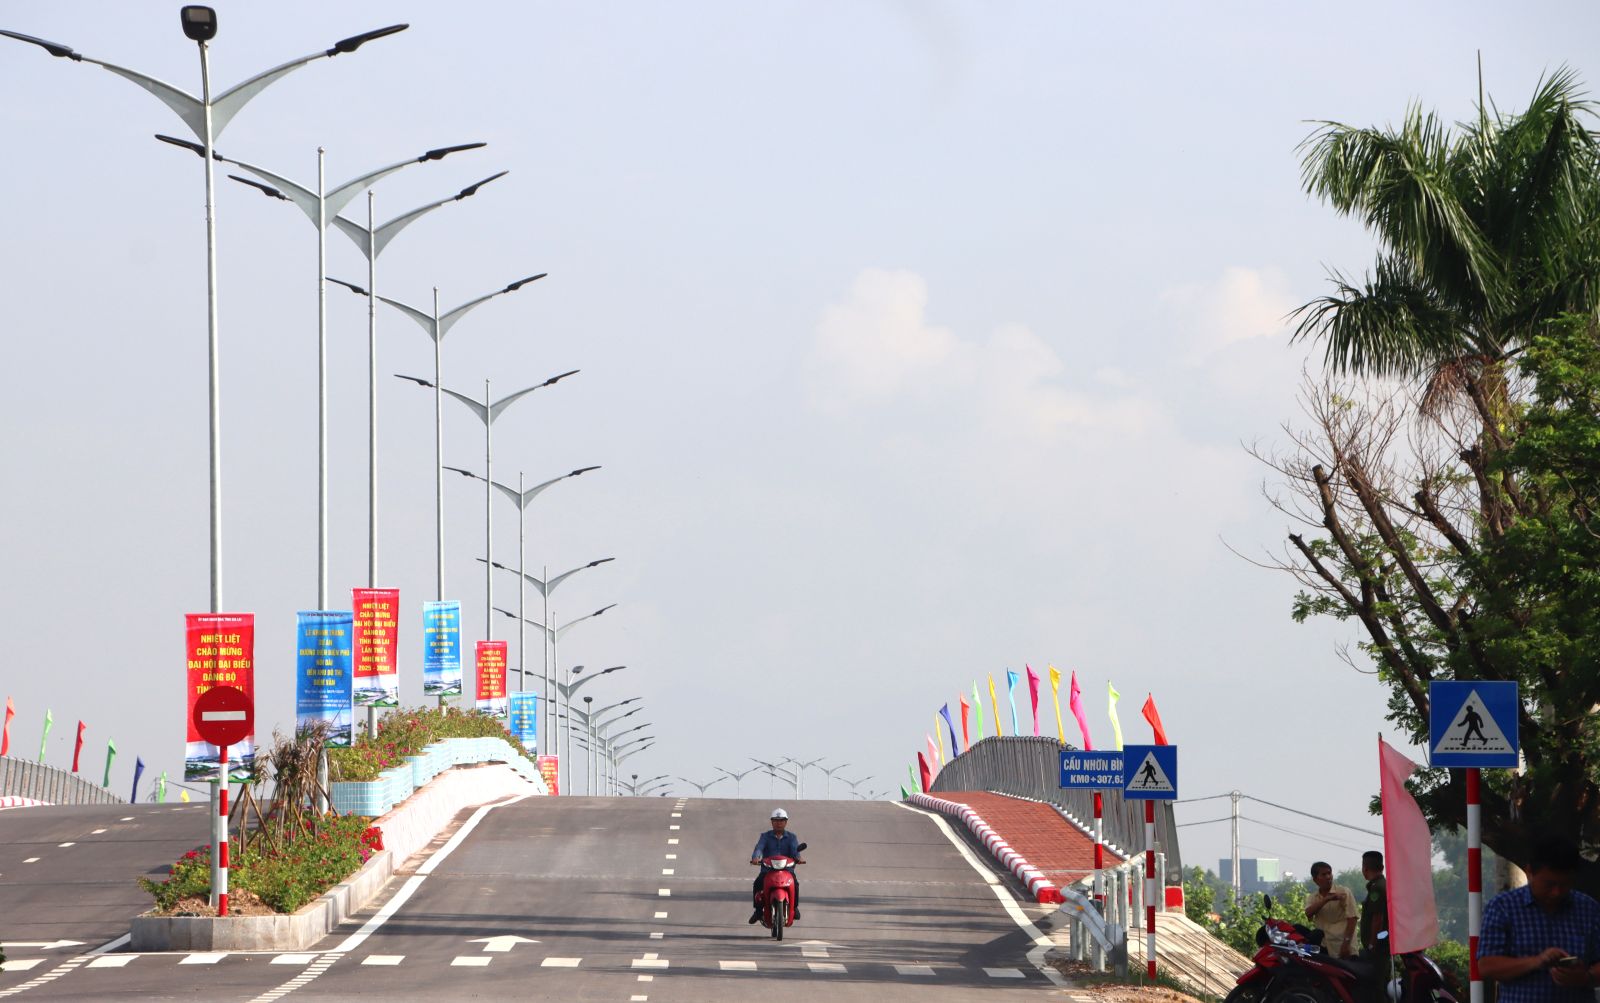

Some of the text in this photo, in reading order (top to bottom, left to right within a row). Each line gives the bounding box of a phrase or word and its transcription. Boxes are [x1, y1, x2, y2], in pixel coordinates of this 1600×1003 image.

[201, 634, 240, 645] NHIỆT LIỆT
[197, 646, 242, 656] CHÀO MỪNG
